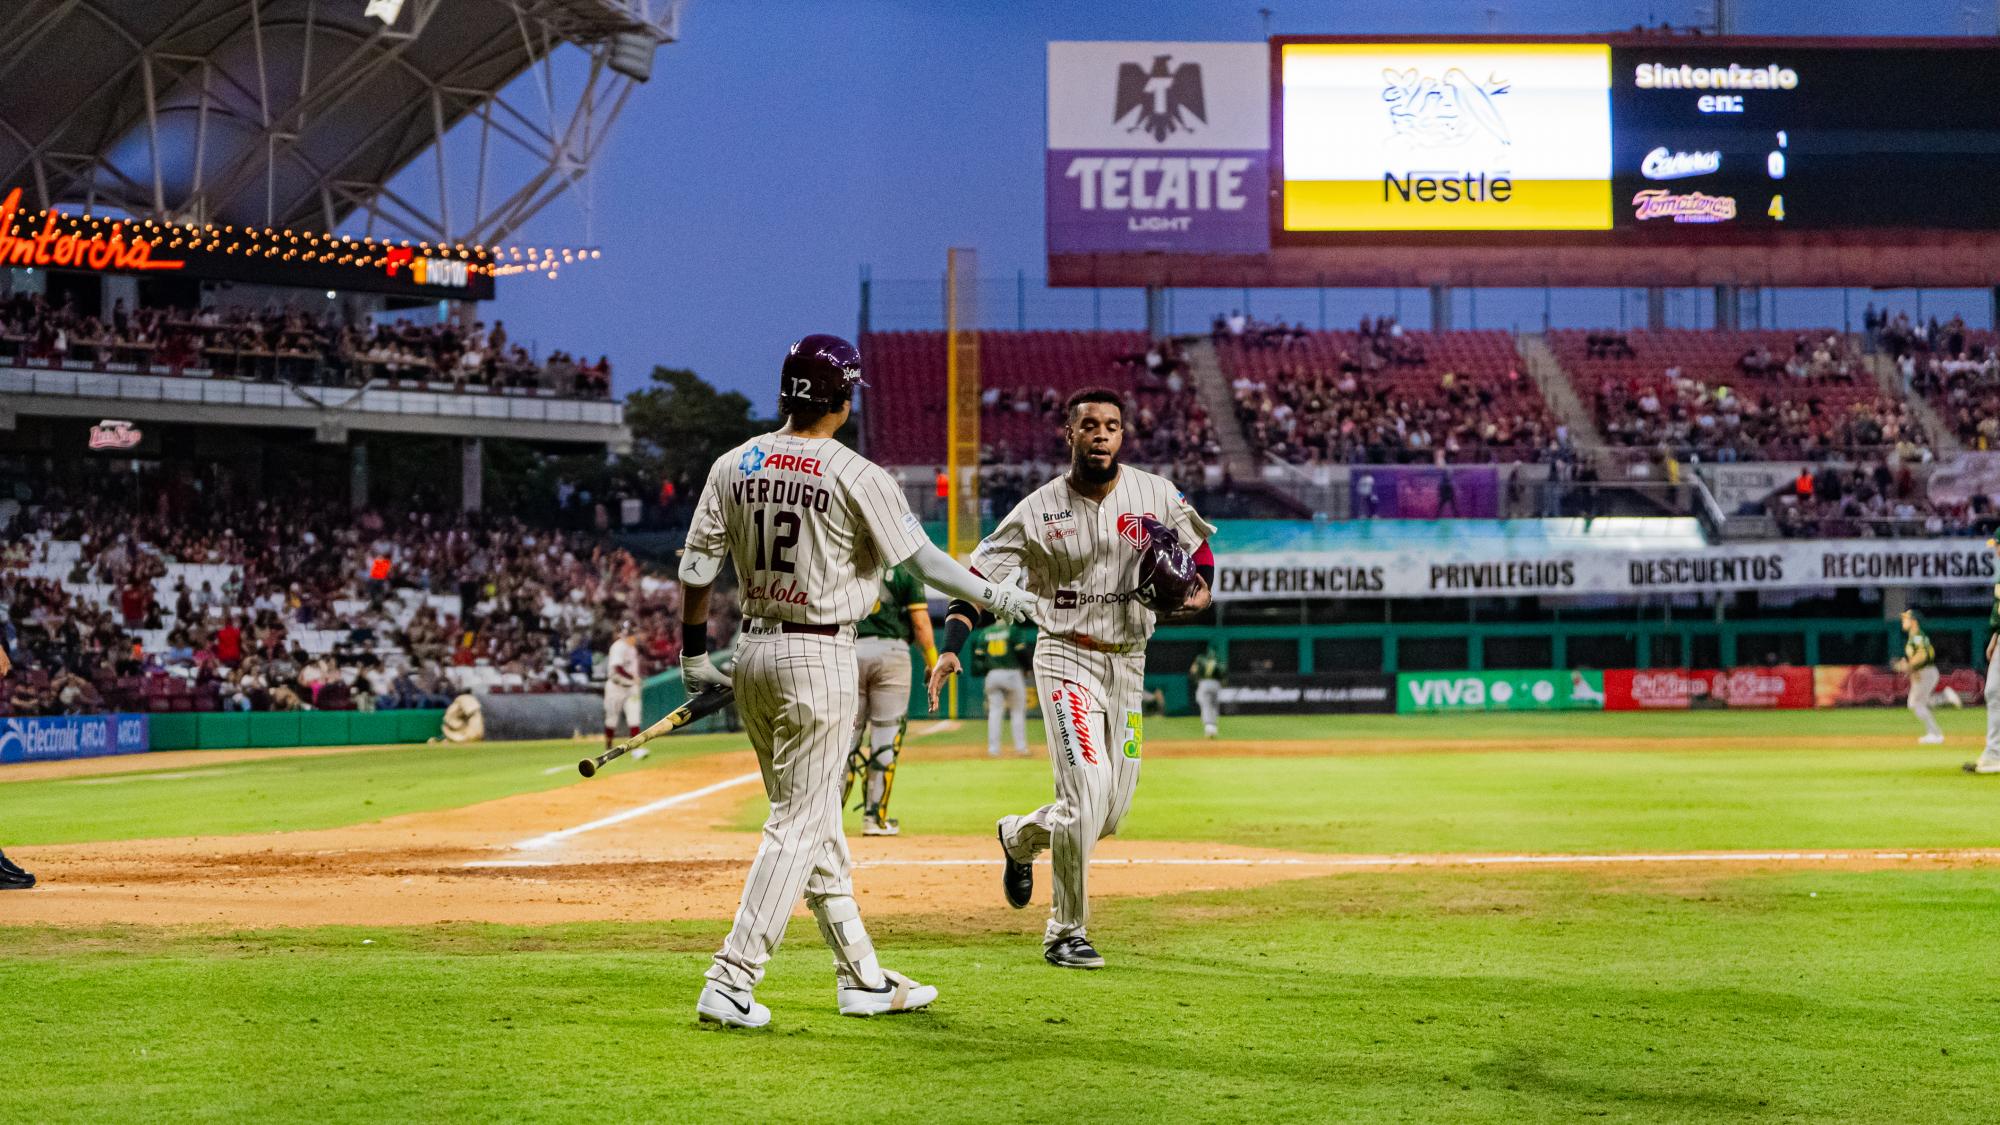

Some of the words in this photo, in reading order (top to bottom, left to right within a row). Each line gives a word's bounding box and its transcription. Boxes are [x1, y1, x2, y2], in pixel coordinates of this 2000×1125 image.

[1635, 63, 1798, 89] Sintonízalo
[1697, 95, 1744, 113] en:
[1776, 130, 1788, 148] 1
[1768, 151, 1785, 180] 0
[1065, 157, 1249, 210] TECATE
[1768, 195, 1785, 221] 4
[1128, 217, 1191, 230] LIGHT
[791, 377, 812, 399] 12
[764, 453, 823, 477] ARIEL
[732, 478, 830, 513] VERDUGO
[1042, 509, 1073, 522] Bruck
[754, 509, 801, 574] 12
[1219, 566, 1384, 592] EXPERIENCIAS
[1430, 561, 1575, 589] PRIVILEGIOS
[1629, 555, 1783, 585] DESCUENTOS
[1822, 552, 1995, 579] RECOMPENSAS
[1054, 702, 1077, 767] caliente.mx
